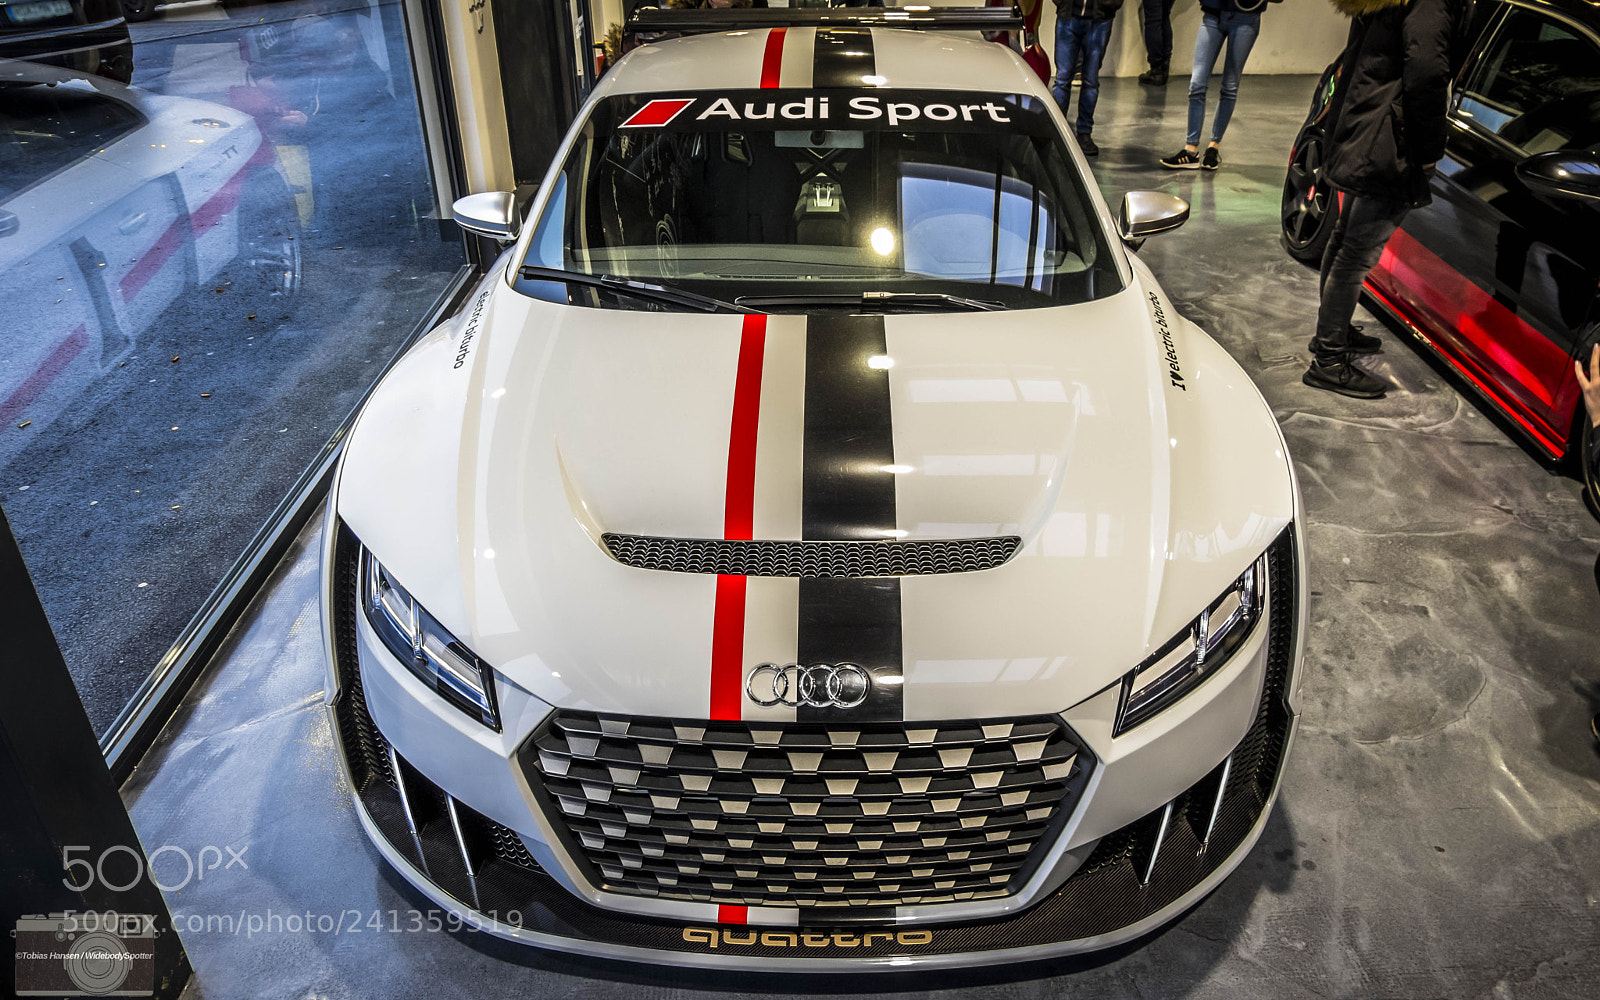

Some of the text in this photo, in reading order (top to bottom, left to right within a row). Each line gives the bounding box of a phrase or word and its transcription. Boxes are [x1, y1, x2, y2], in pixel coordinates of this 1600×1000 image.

[696, 97, 1011, 126] Audi Sport
[453, 325, 479, 369] biturbo
[1148, 291, 1186, 391] I electric biturbo
[682, 926, 933, 948] quattro
